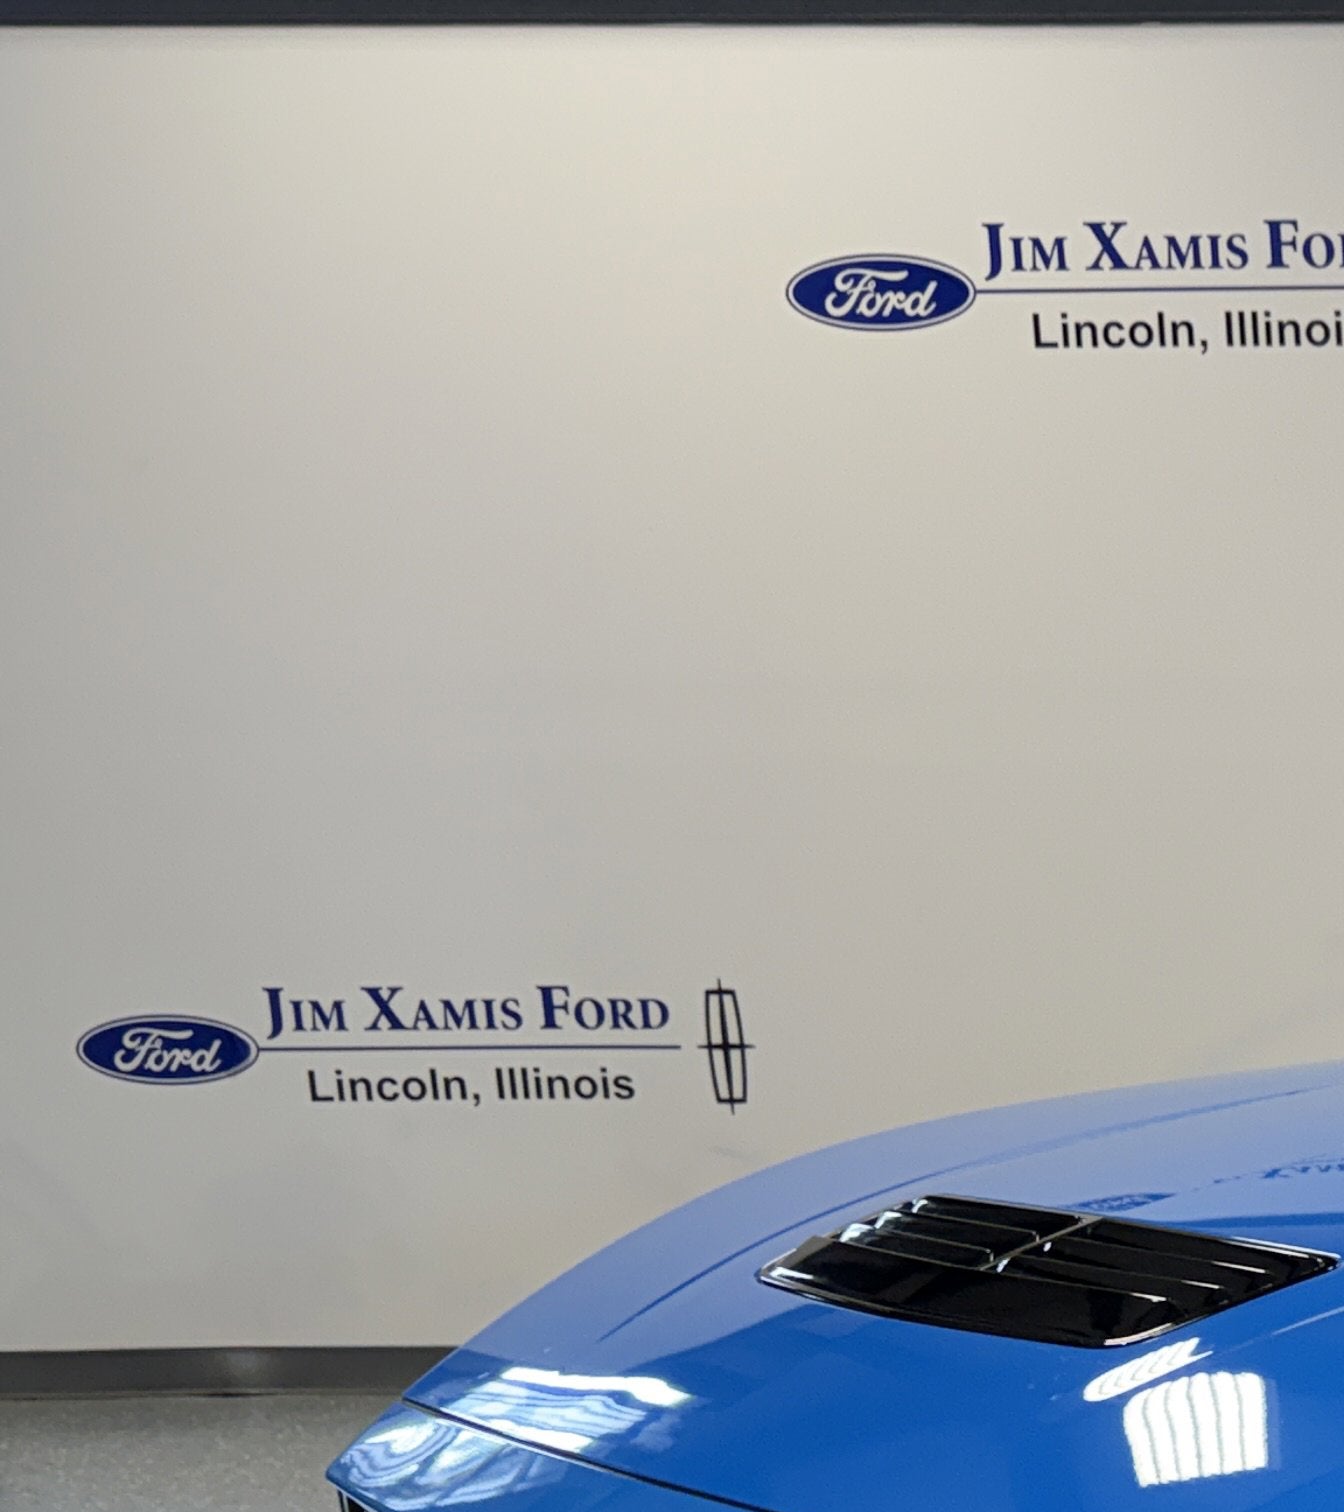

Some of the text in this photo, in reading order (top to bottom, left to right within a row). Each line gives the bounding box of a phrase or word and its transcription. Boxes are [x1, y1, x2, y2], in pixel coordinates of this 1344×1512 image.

[981, 222, 1069, 281] JIM
[1082, 221, 1249, 272] XAMIS
[825, 267, 938, 320] Ford
[1031, 311, 1208, 354] Lincoln,
[262, 985, 670, 1041] JIM XAMIS FORD
[113, 1027, 222, 1074] Ford
[307, 1067, 636, 1107] Lincoln, Illinois
